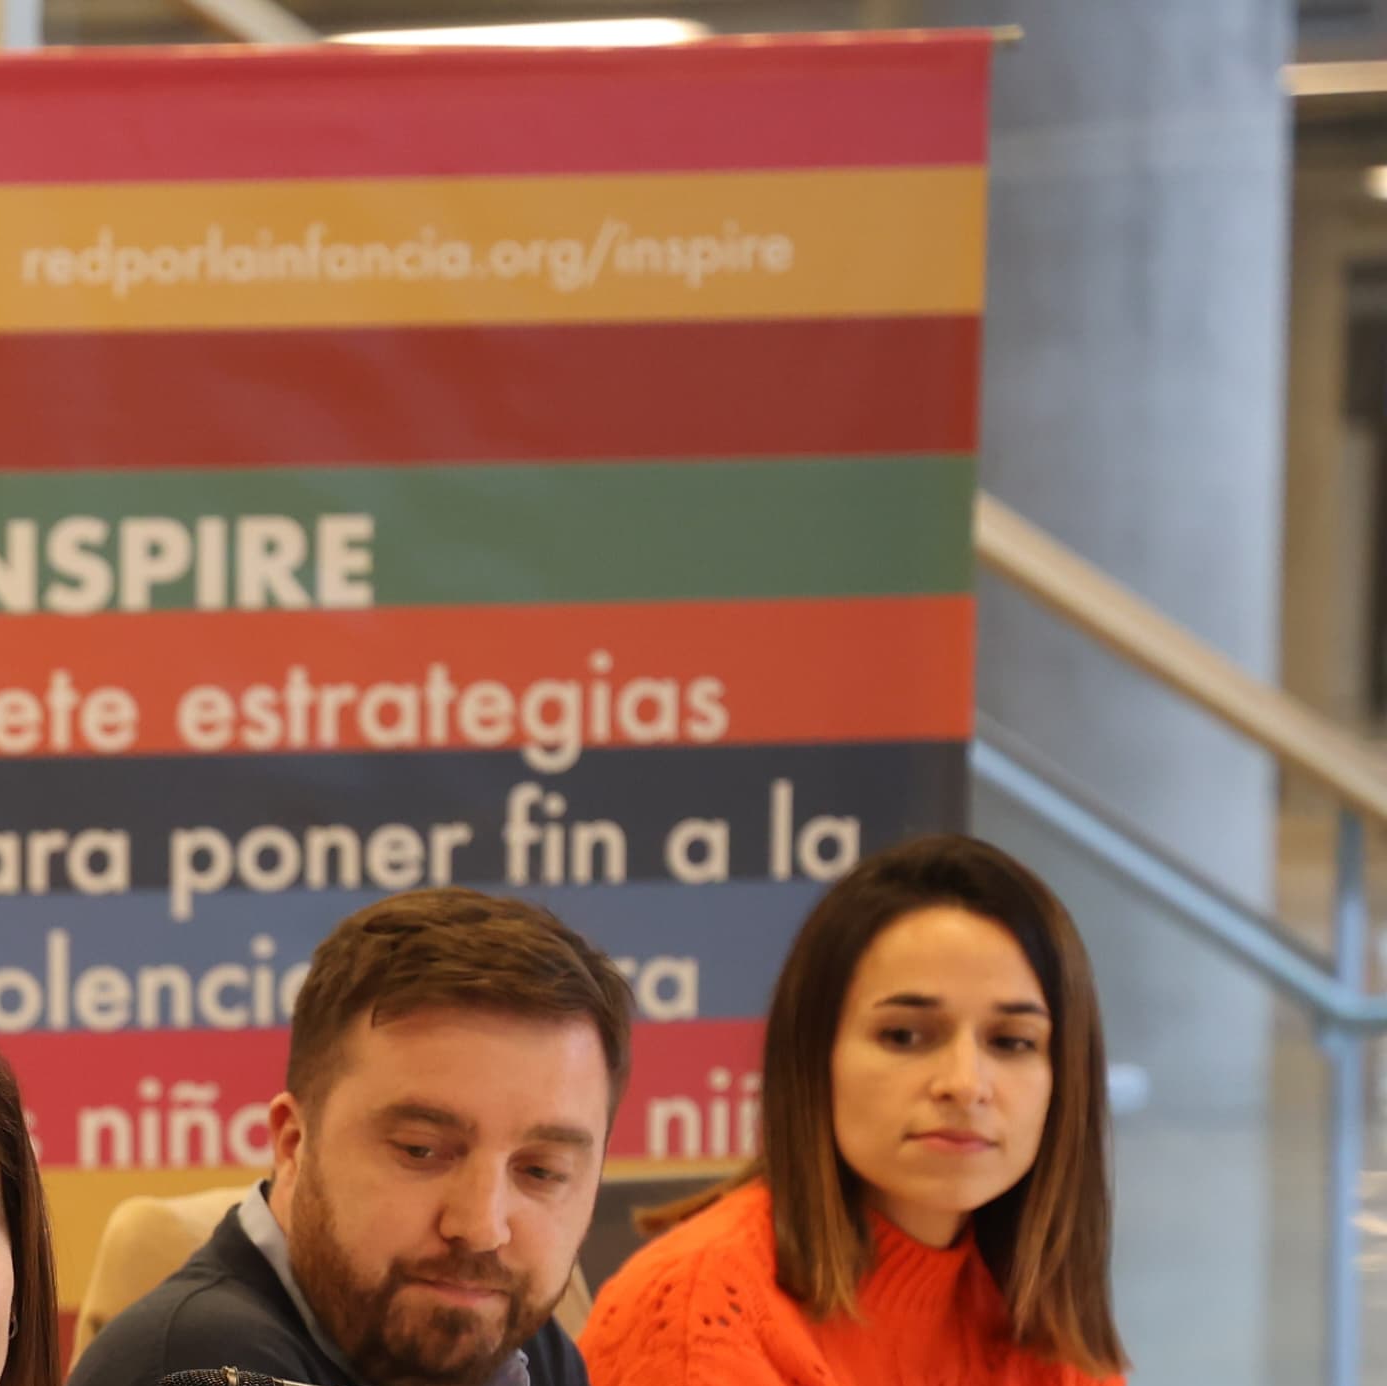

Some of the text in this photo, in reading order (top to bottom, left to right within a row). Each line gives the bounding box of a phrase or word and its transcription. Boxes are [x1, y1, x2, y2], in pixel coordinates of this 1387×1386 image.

[22, 218, 795, 296] redporlainfancia.org/inspire
[177, 650, 729, 773] estrategias
[170, 821, 470, 920] poner
[504, 782, 626, 885] fin
[666, 815, 730, 884] a
[769, 778, 860, 880] la
[77, 1074, 275, 1170] niño
